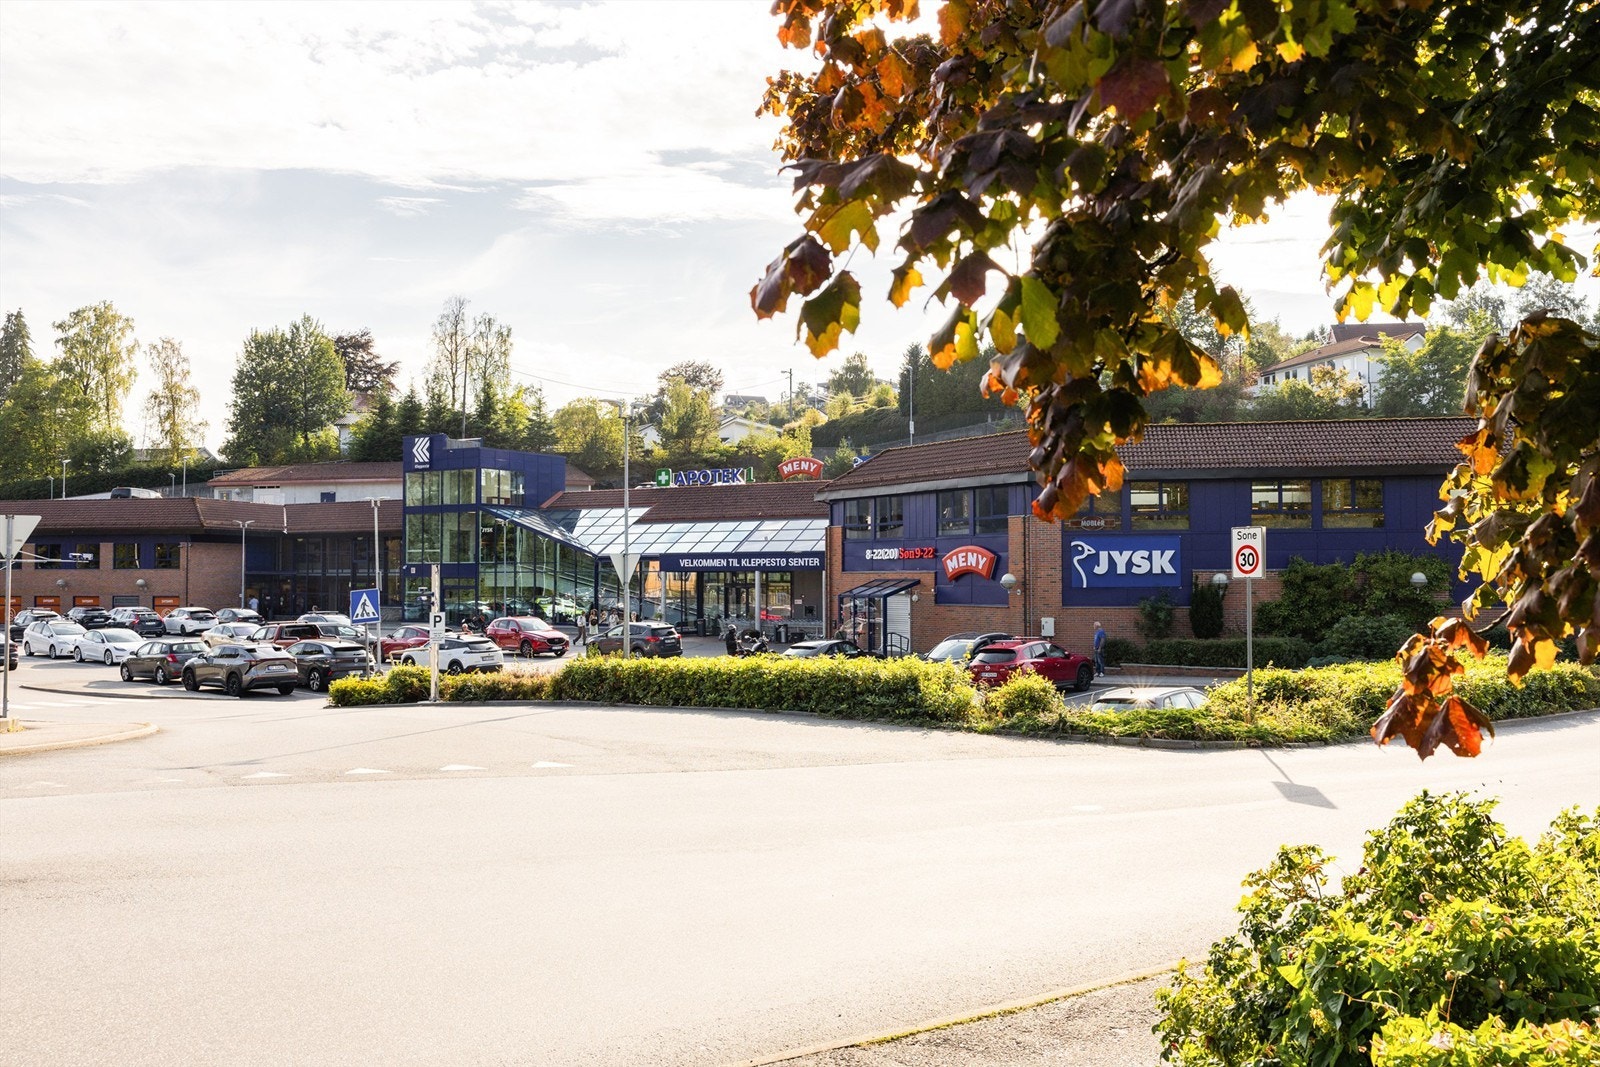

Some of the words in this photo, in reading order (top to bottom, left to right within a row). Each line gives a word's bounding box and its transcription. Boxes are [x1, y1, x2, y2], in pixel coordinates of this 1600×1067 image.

[782, 460, 818, 474] MENY
[674, 468, 743, 485] APOTEK
[745, 466, 755, 482] 1
[1236, 530, 1257, 541] Sone
[679, 558, 727, 567] VELKOMMEN
[728, 558, 740, 567] TIL
[741, 558, 787, 567] KLEPPESTØ
[788, 557, 820, 567] SENTER
[946, 552, 988, 572] MENY
[1093, 549, 1177, 575] JYSK
[1240, 552, 1255, 567] 30
[433, 615, 442, 628] P
